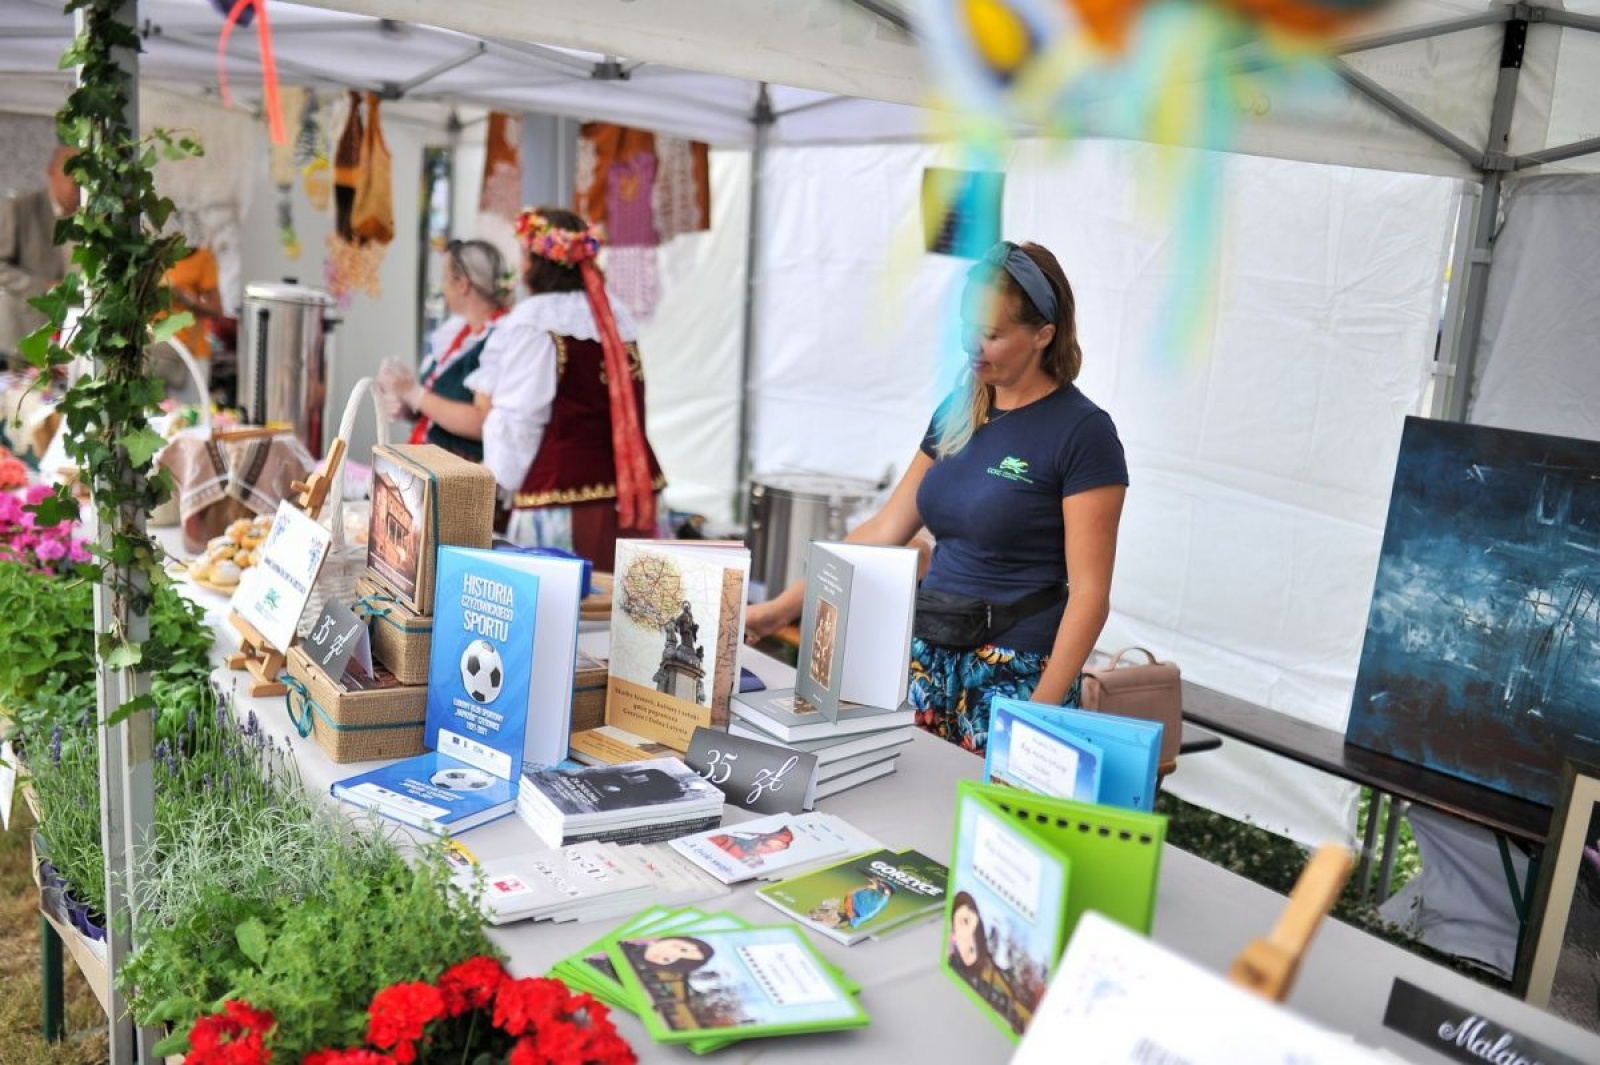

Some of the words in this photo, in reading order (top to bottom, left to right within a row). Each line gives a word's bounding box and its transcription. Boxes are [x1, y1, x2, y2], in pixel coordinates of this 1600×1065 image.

[463, 572, 514, 609] HISTORIA
[312, 615, 337, 645] 35
[322, 623, 360, 665] zł
[463, 610, 510, 643] SPORTU
[697, 748, 738, 783] 35
[746, 755, 799, 804] zł
[870, 860, 944, 897] GORZYCE
